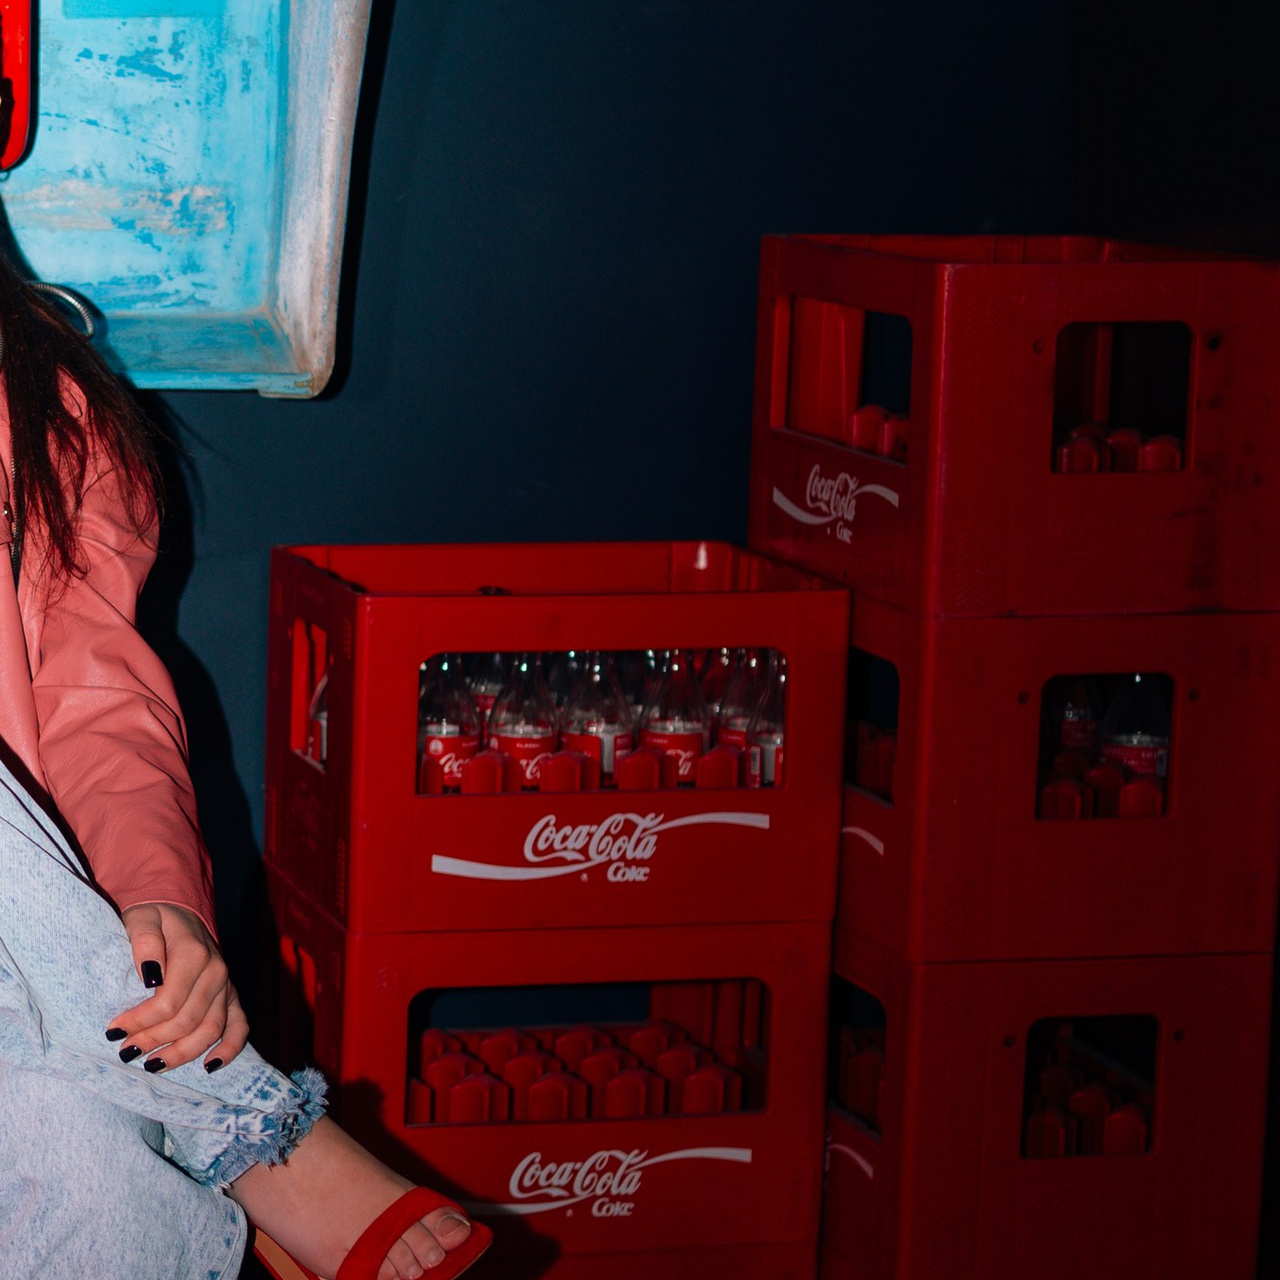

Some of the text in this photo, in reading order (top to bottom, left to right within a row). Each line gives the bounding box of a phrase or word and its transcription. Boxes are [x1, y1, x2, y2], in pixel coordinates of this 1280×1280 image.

[806, 463, 859, 522] Coca-Cola
[523, 812, 664, 862] Coca-Cola
[606, 861, 651, 883] Coke
[508, 1149, 649, 1199] Coca-Cola
[591, 1197, 635, 1218] Coke
